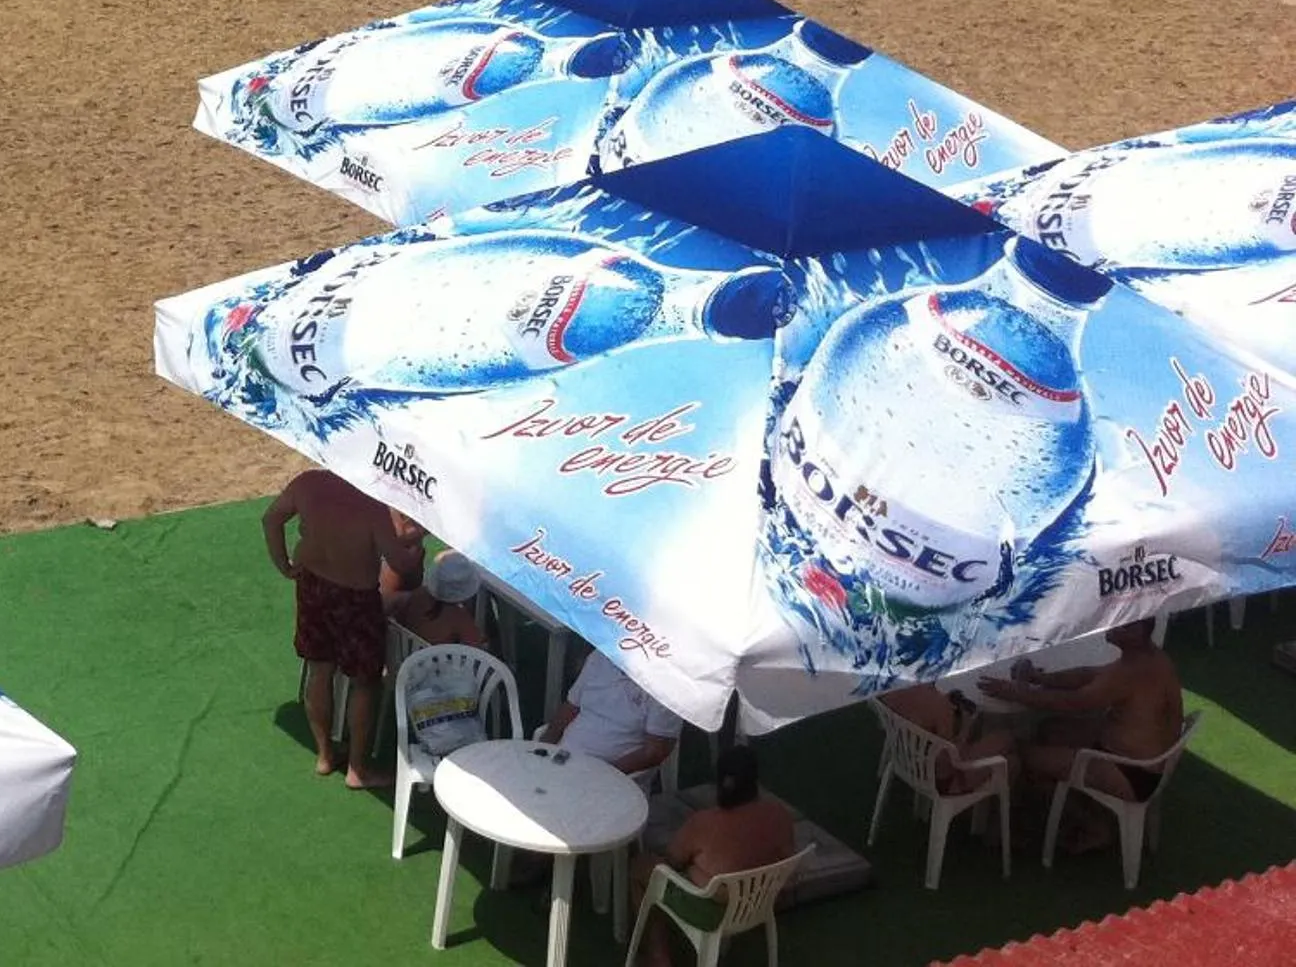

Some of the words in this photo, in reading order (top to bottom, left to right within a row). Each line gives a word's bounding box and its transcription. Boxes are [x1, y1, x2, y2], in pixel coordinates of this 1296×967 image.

[909, 101, 936, 141] de
[925, 112, 986, 174] energie
[340, 156, 385, 192] BORSEC
[523, 275, 573, 338] BORSEC
[932, 334, 1030, 406] BORSEC
[480, 399, 626, 441] Izvor
[622, 403, 694, 445] de
[1126, 402, 1193, 497] Izvor
[1172, 359, 1213, 419] de
[1207, 372, 1280, 470] energie
[373, 440, 438, 500] BORSEC
[560, 446, 737, 496] energie
[779, 416, 988, 583] BORSEC
[511, 529, 572, 577] Izvor
[568, 572, 601, 599] de
[602, 598, 672, 661] energie
[1098, 555, 1182, 597] BORSEC
